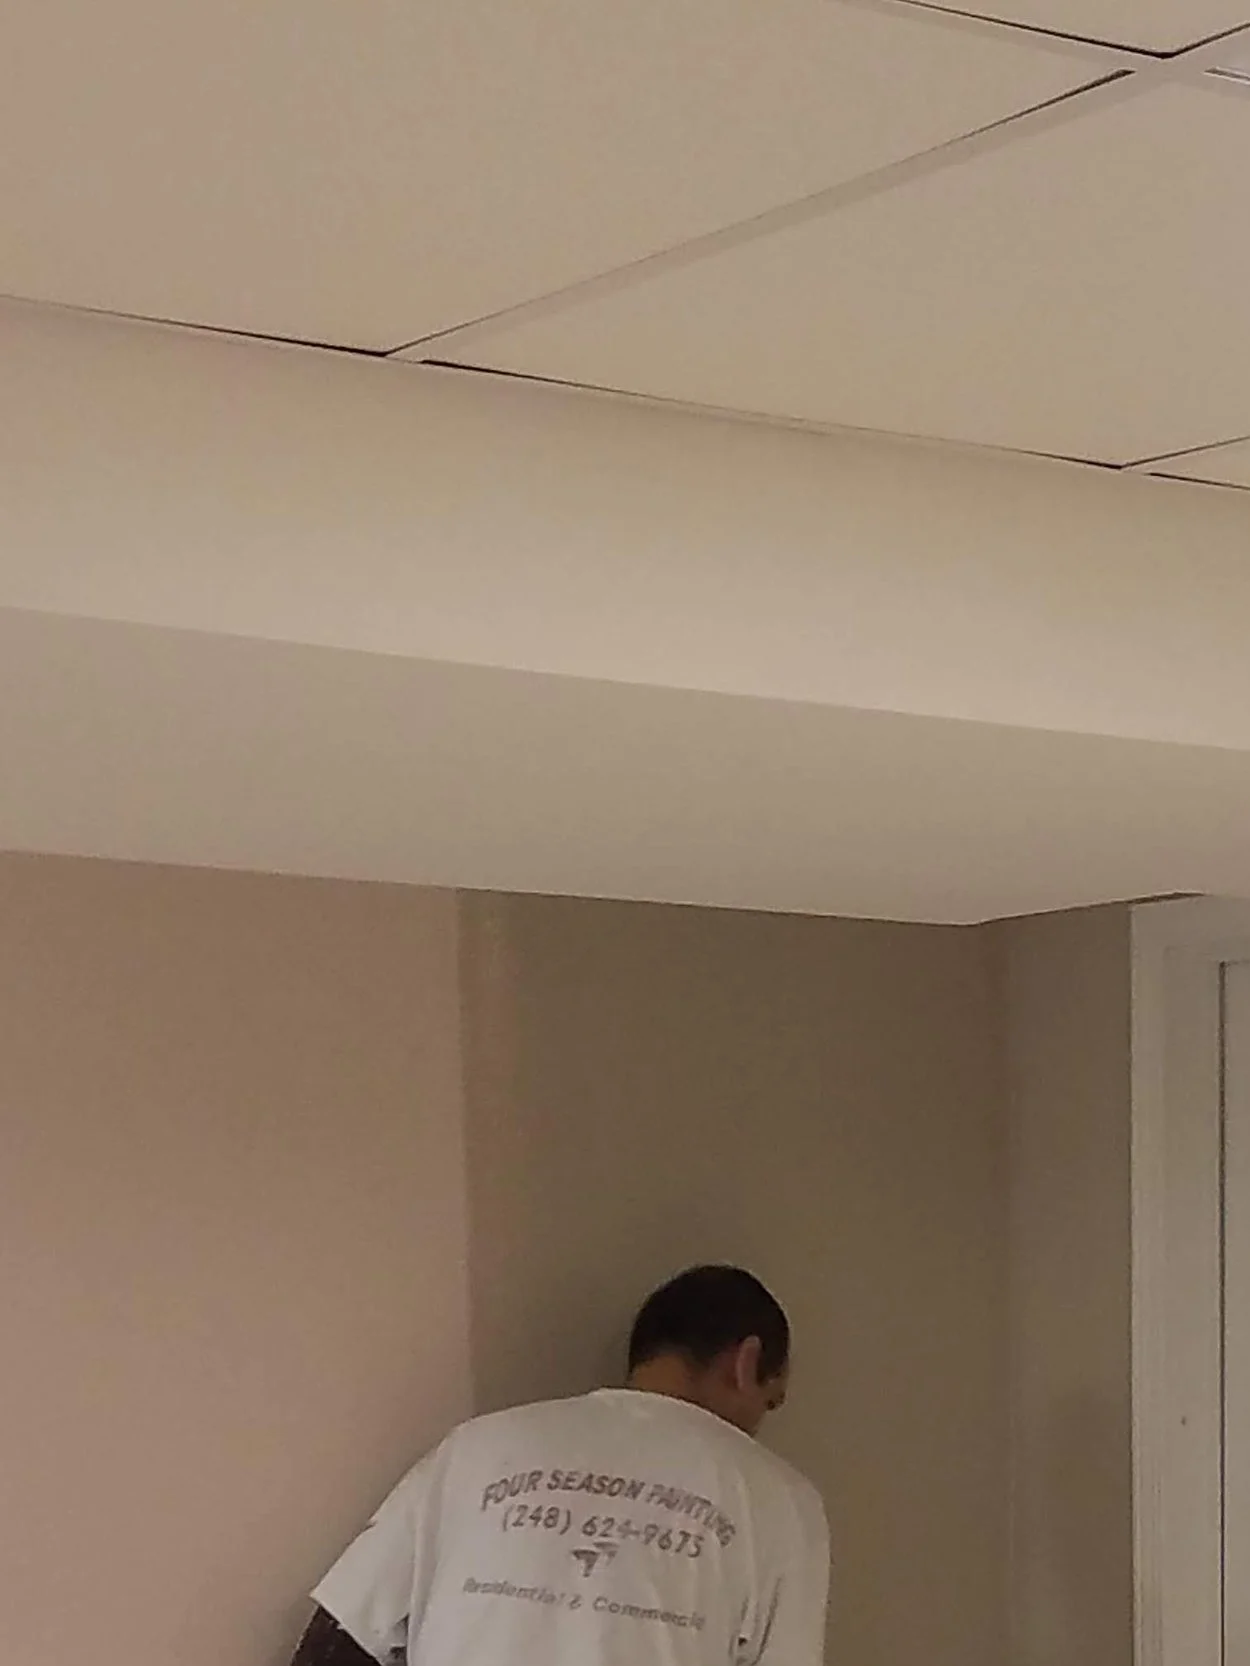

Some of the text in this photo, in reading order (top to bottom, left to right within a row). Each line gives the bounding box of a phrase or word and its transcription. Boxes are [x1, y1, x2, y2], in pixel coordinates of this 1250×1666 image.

[481, 1470, 544, 1512] FOUR
[547, 1469, 645, 1501] SEASON
[502, 1504, 705, 1558] (248) 624-9675
